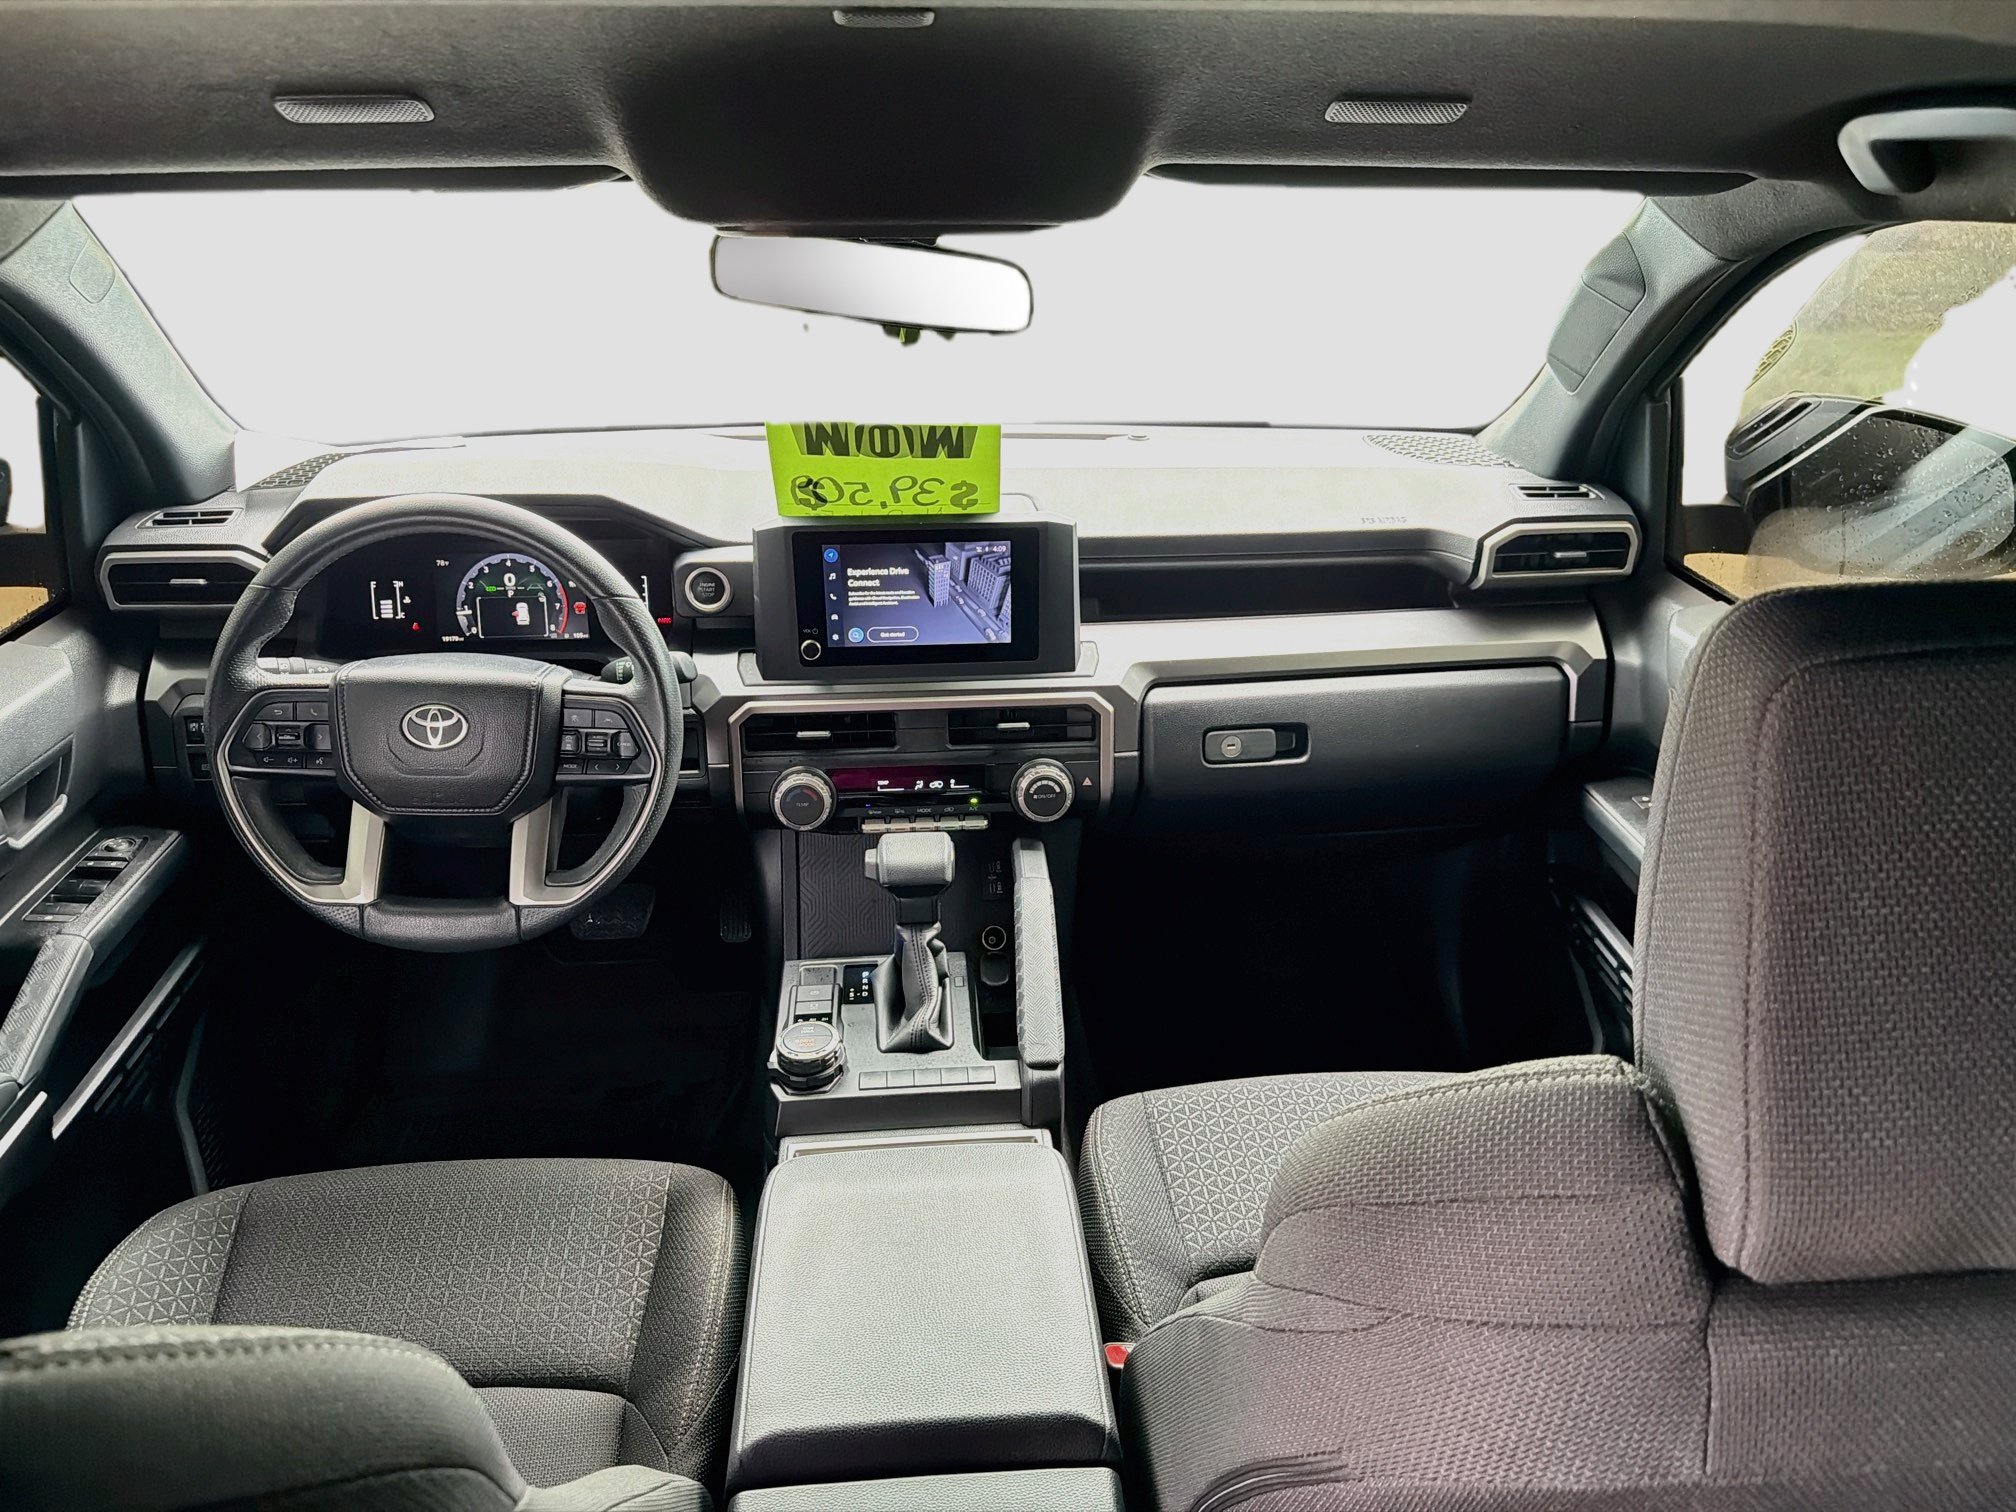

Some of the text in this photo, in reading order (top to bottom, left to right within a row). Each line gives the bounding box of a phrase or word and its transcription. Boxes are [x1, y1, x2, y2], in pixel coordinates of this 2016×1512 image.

[505, 559, 511, 567] 4
[529, 564, 535, 572] 5
[847, 567, 909, 577] Experience Drive
[503, 573, 516, 586] 0
[847, 579, 880, 587] Connect
[507, 589, 514, 598] P
